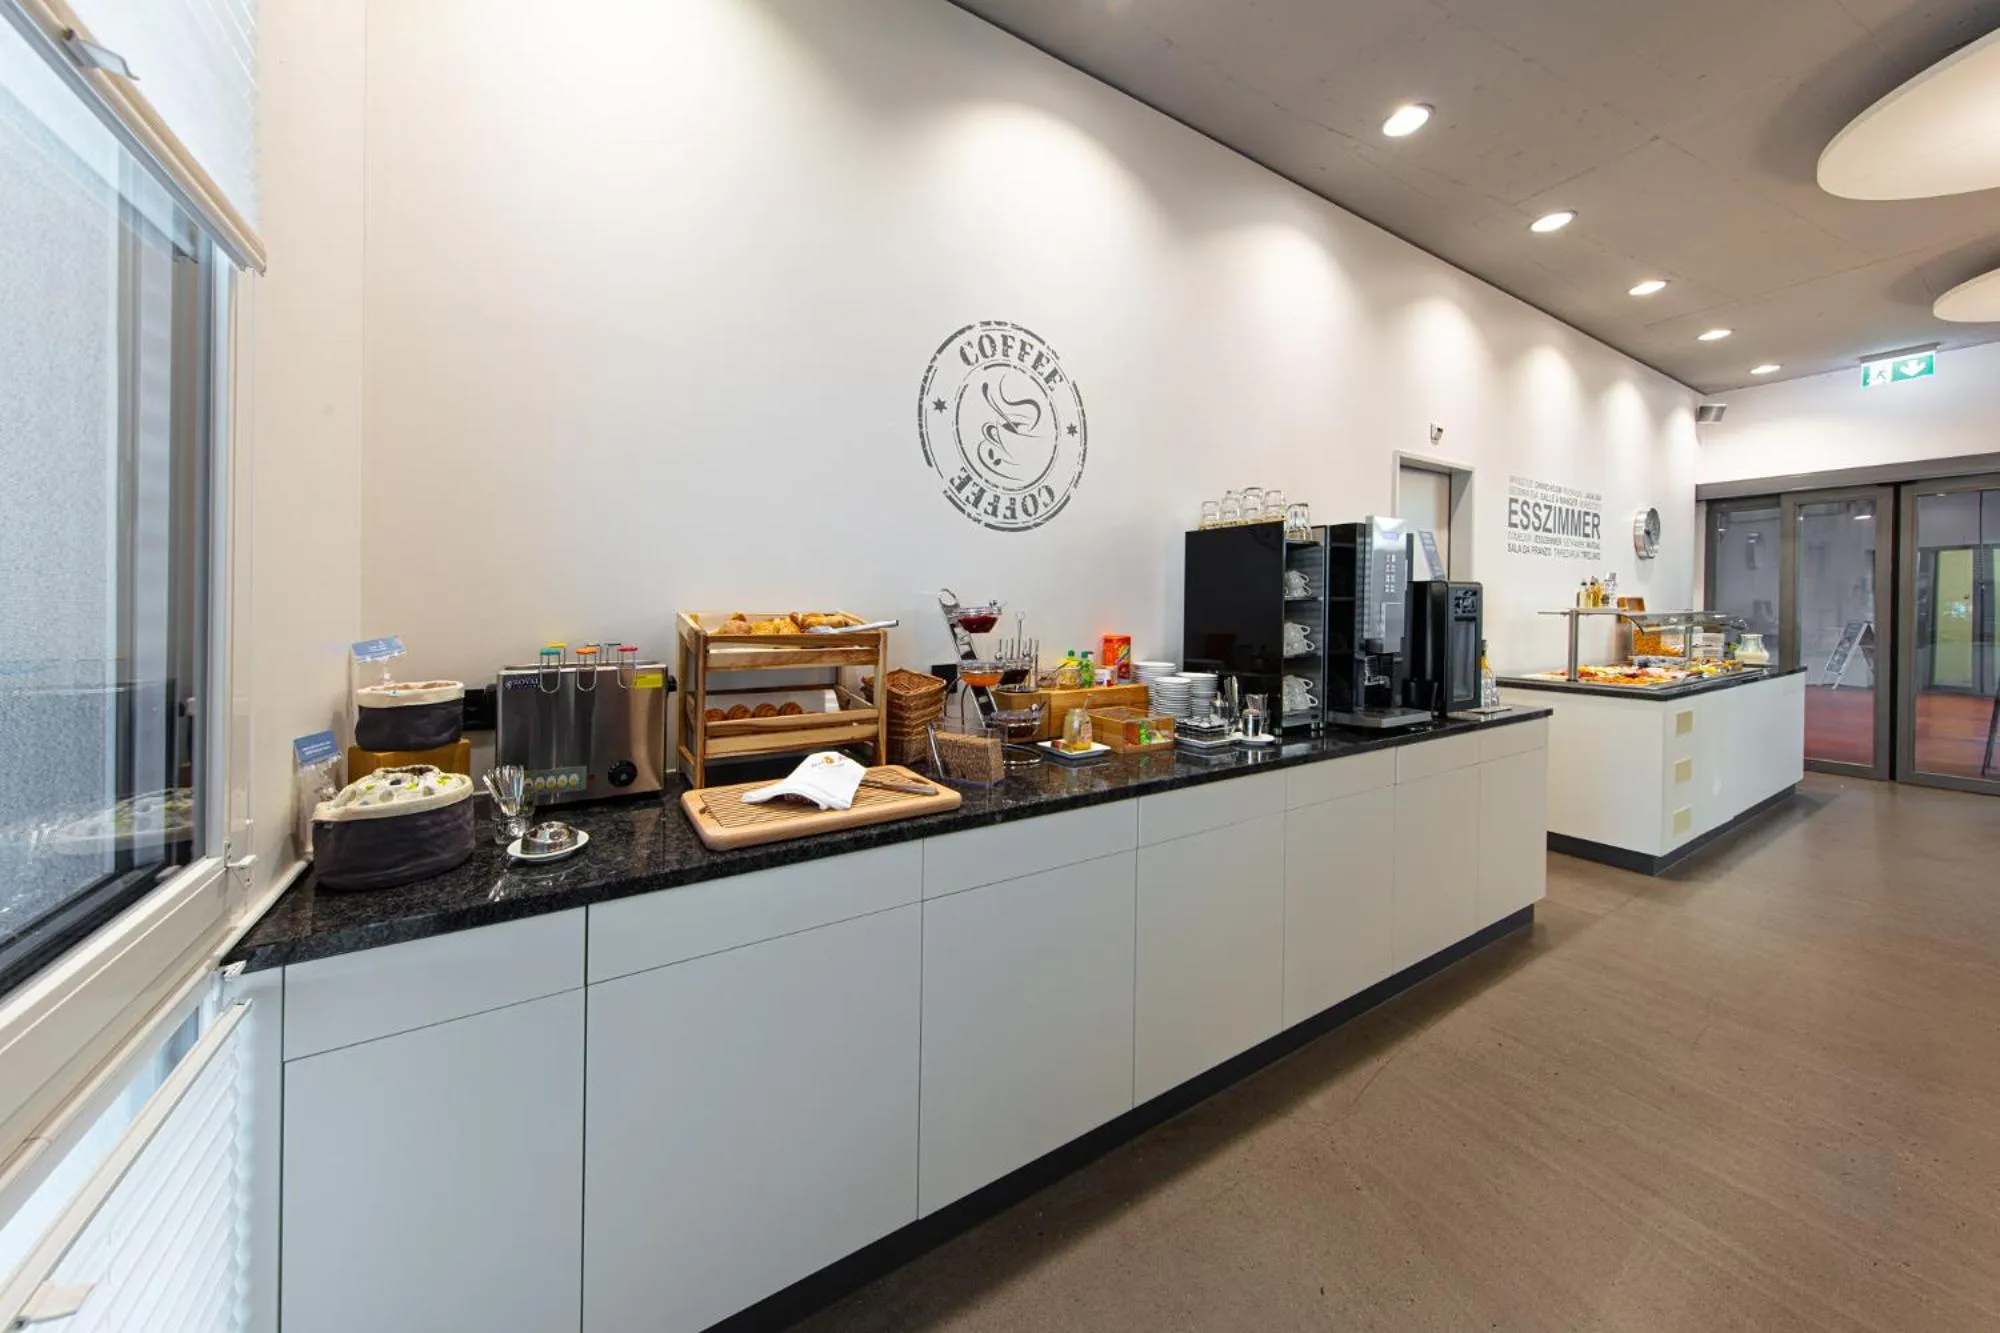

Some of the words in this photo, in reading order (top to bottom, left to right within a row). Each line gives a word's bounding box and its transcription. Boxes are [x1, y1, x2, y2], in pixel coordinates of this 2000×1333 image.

[959, 333, 1064, 393] COFFEE
[949, 466, 1056, 520] COFFEE
[1508, 497, 1601, 540] ESSZIMMER
